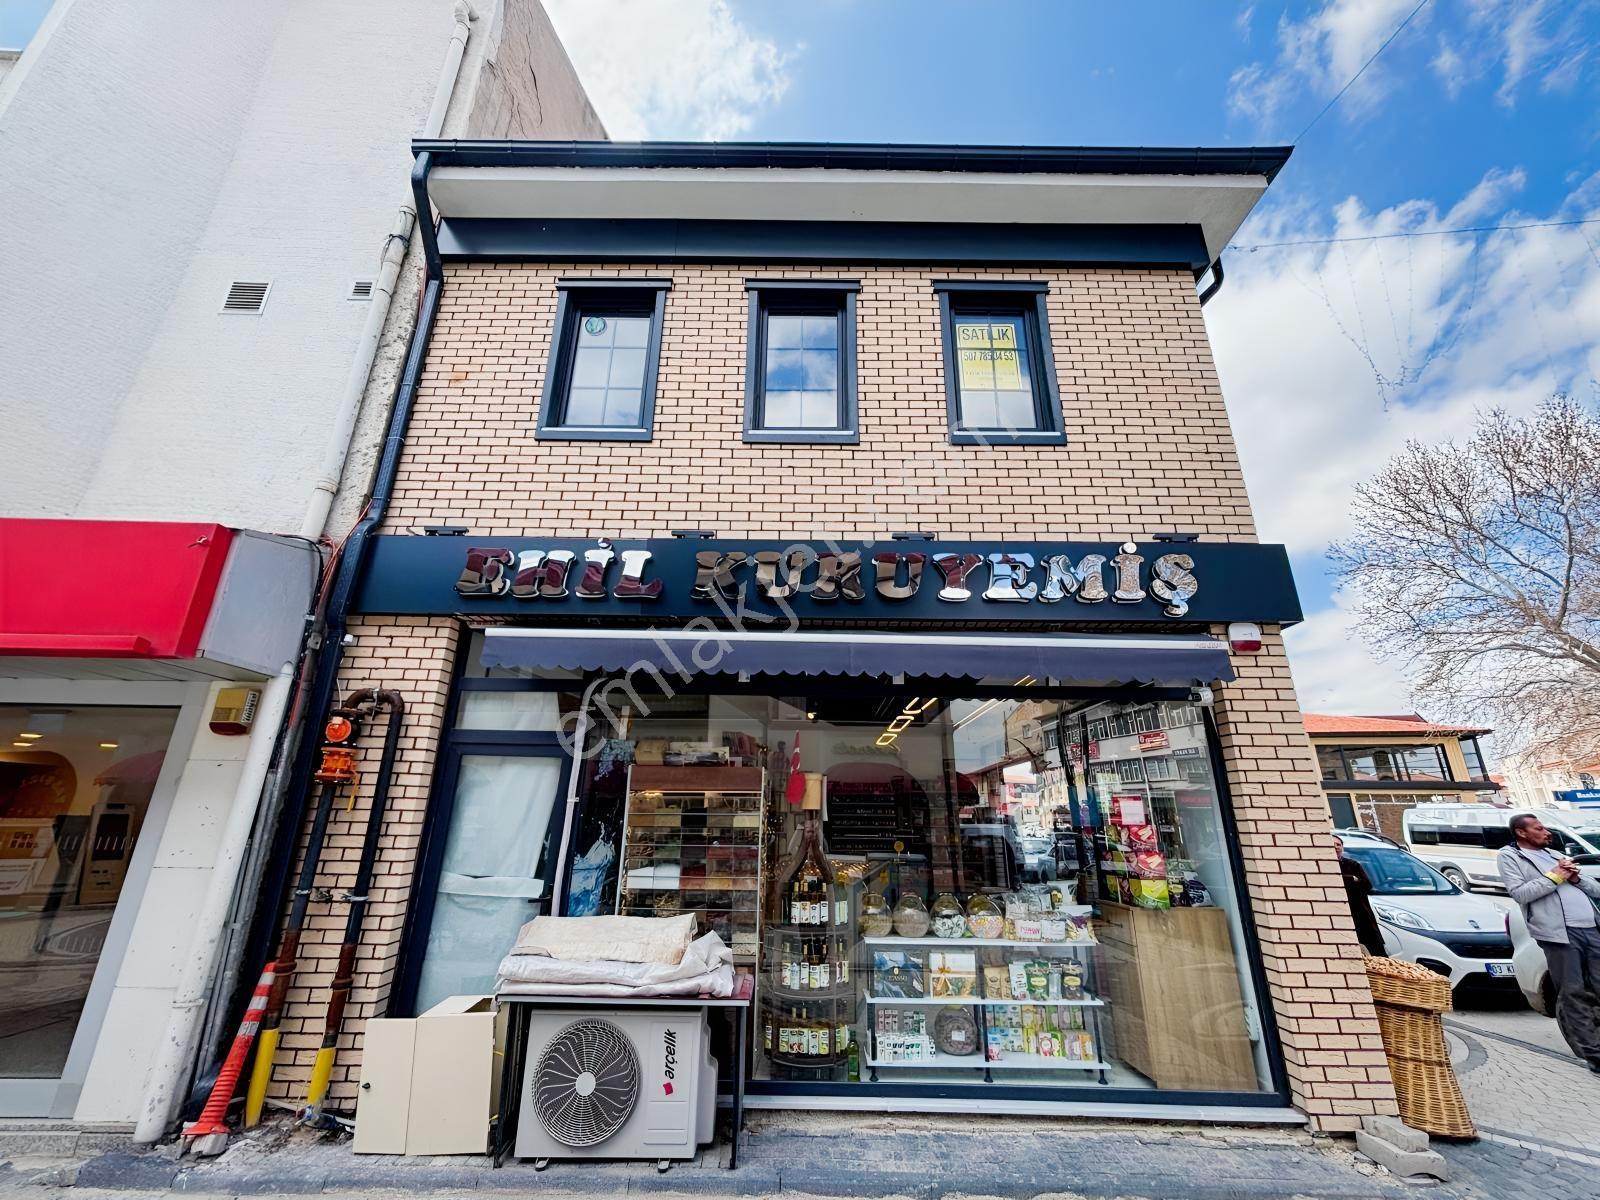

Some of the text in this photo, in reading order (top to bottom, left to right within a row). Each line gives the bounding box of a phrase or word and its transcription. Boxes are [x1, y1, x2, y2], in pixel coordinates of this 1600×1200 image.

[962, 328, 1010, 341] SATLIK
[691, 542, 1199, 618] KURUYEMİŞ
[663, 1028, 678, 1081] arçelik
